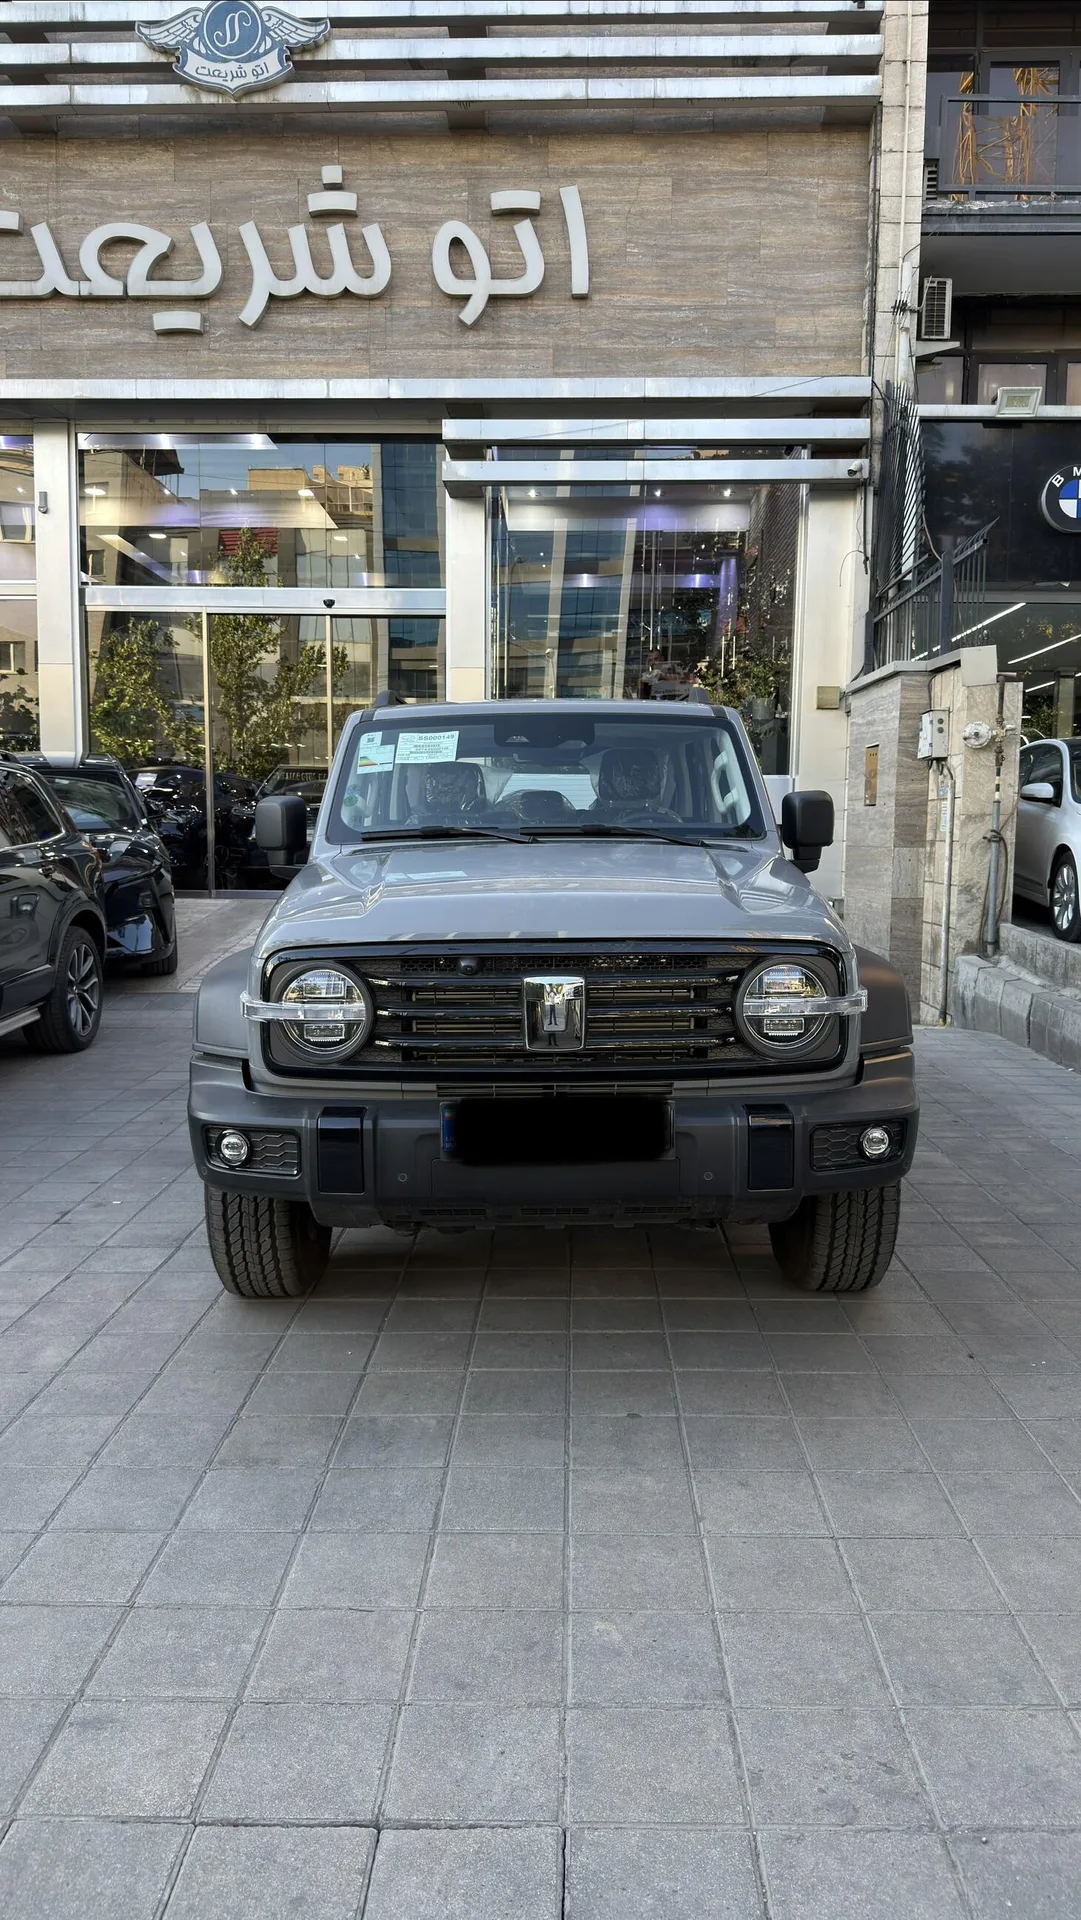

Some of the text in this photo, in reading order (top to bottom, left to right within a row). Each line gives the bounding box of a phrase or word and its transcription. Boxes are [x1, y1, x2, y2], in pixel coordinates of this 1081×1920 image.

[195, 62, 269, 82] اتو شریعت
[432, 184, 591, 328] اتو
[1051, 466, 1081, 488] BM
